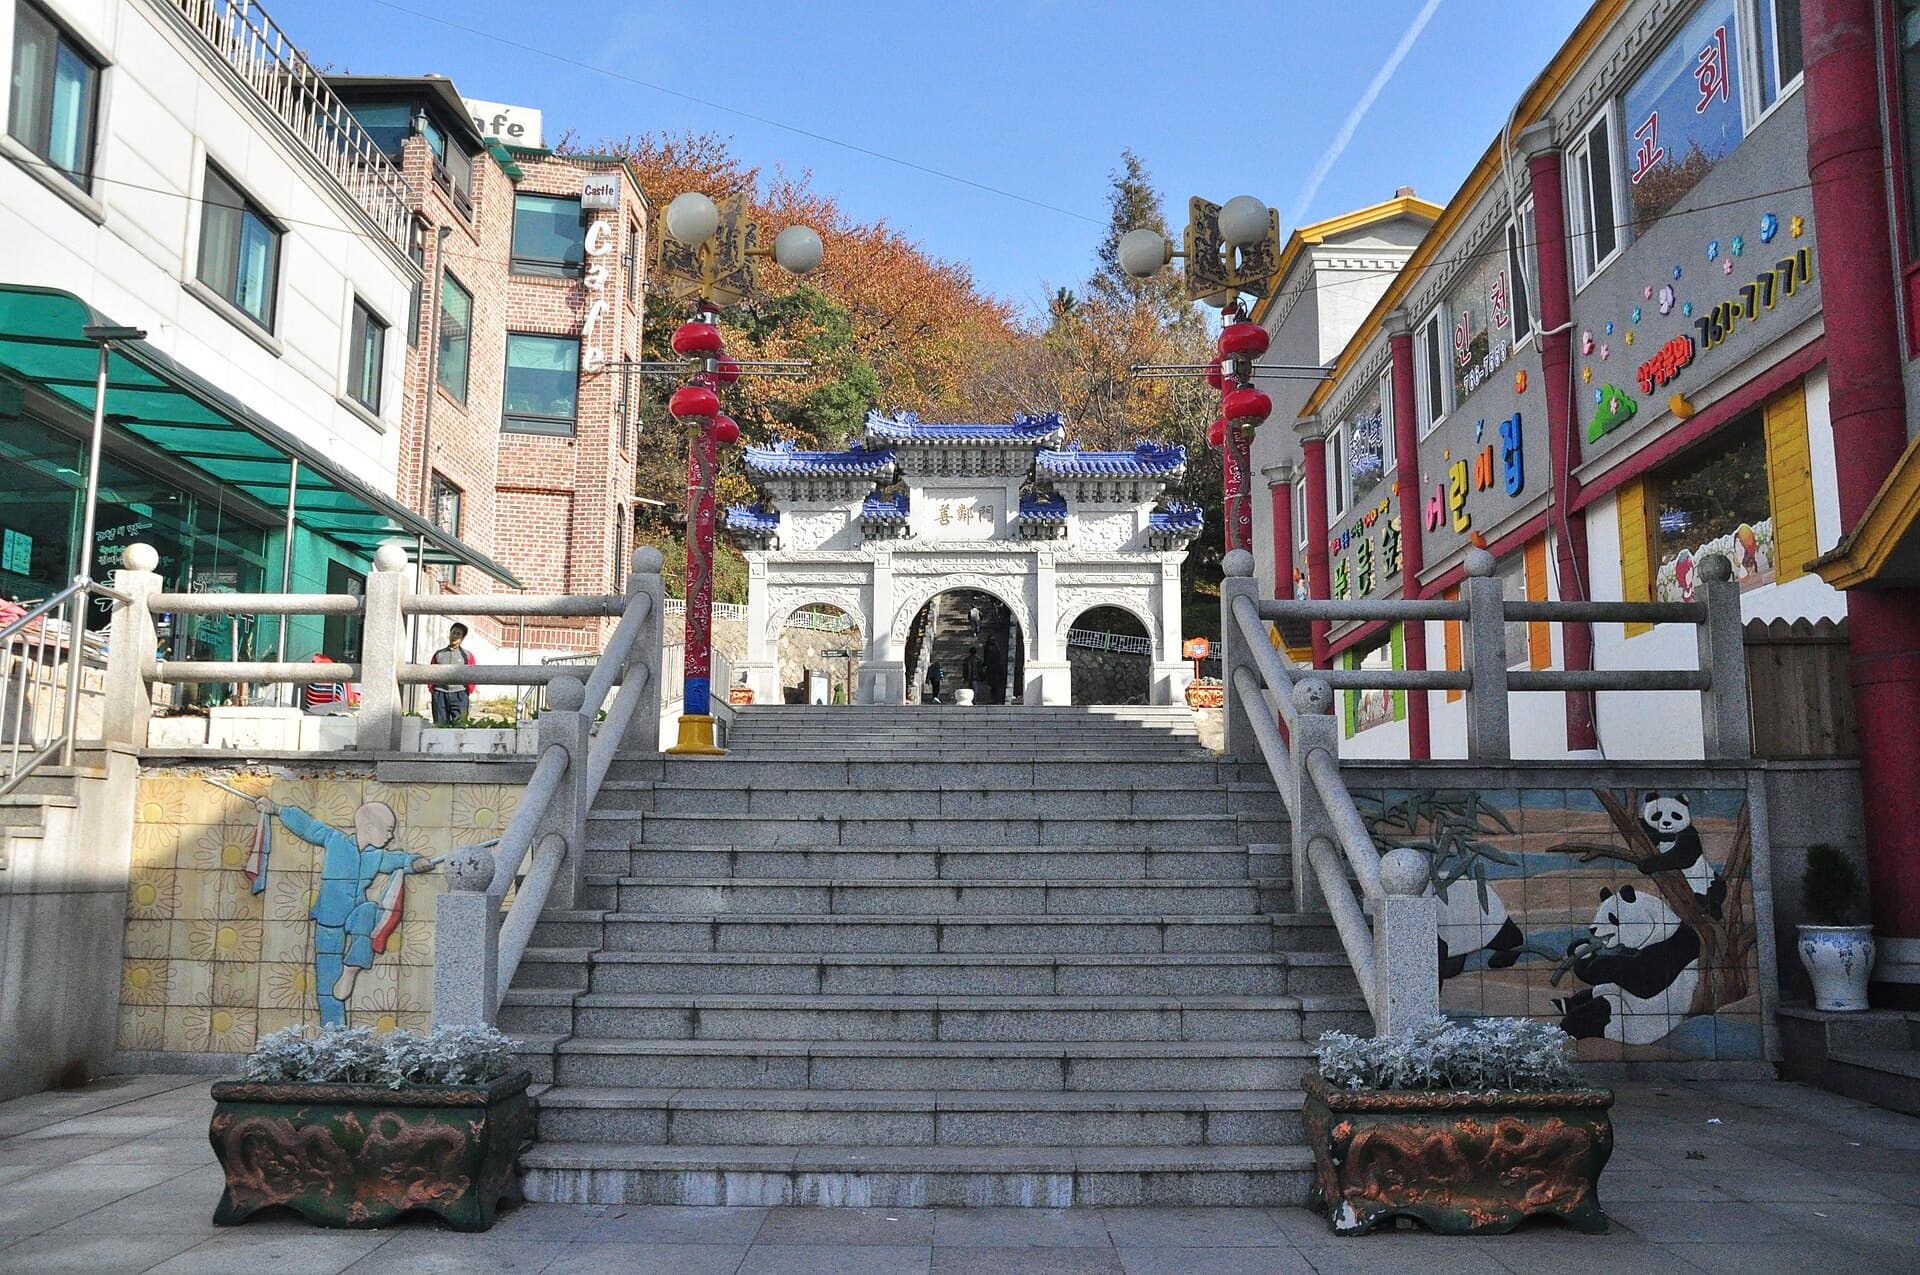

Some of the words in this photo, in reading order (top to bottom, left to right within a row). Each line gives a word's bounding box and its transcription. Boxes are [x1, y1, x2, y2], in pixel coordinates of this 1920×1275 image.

[473, 108, 525, 138] afé
[1631, 25, 1730, 184] 교회
[584, 184, 614, 196] Castle
[582, 220, 612, 374] Cafe
[1636, 335, 1694, 395] 상담문의
[1334, 520, 1399, 600] 푸른숲
[1425, 412, 1524, 534] 어린이집
